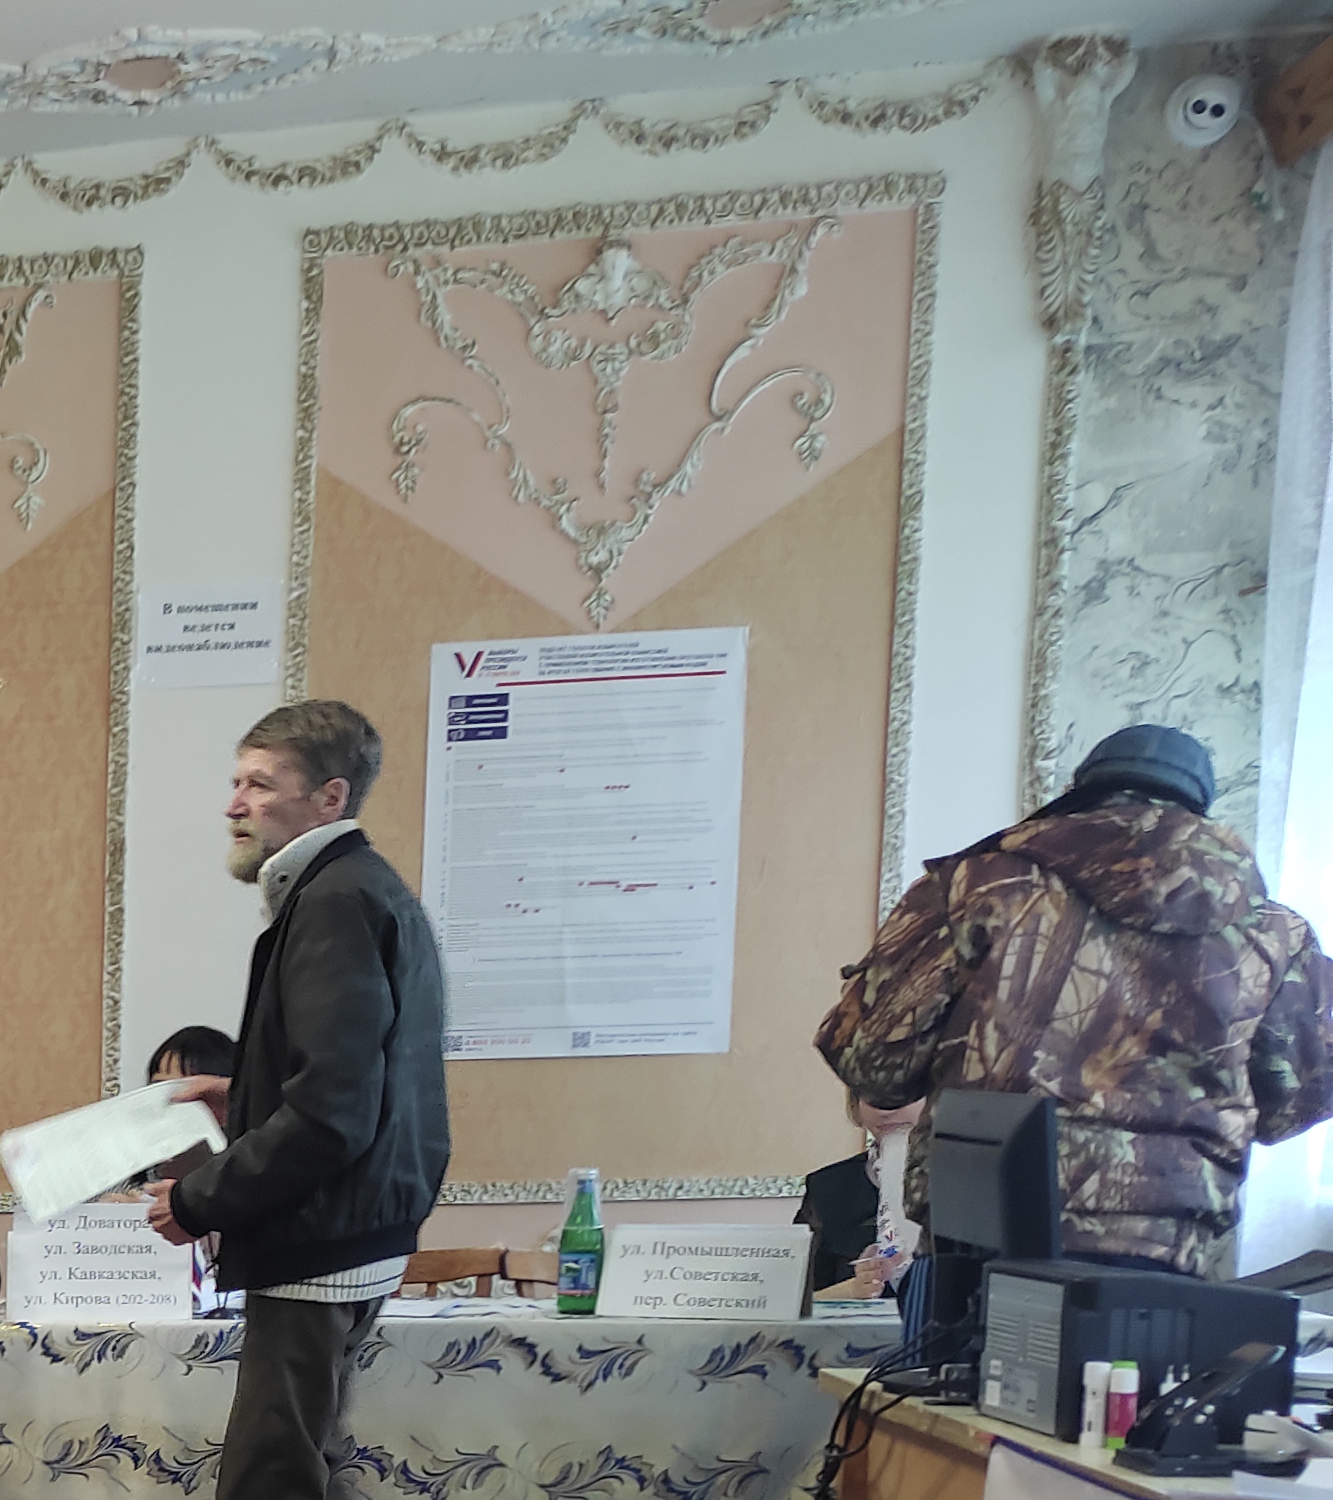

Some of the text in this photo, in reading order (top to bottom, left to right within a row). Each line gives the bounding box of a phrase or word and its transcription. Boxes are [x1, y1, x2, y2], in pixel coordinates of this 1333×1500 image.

[162, 603, 173, 615] В
[47, 1218, 69, 1233] ул.
[44, 1241, 158, 1259] ул. Заводская,
[619, 1243, 646, 1258] ул.
[39, 1267, 162, 1284] ул. Кавказская,
[24, 1294, 47, 1309] ул.
[52, 1292, 111, 1308] Кирова
[632, 1292, 768, 1310] пер. Советский
